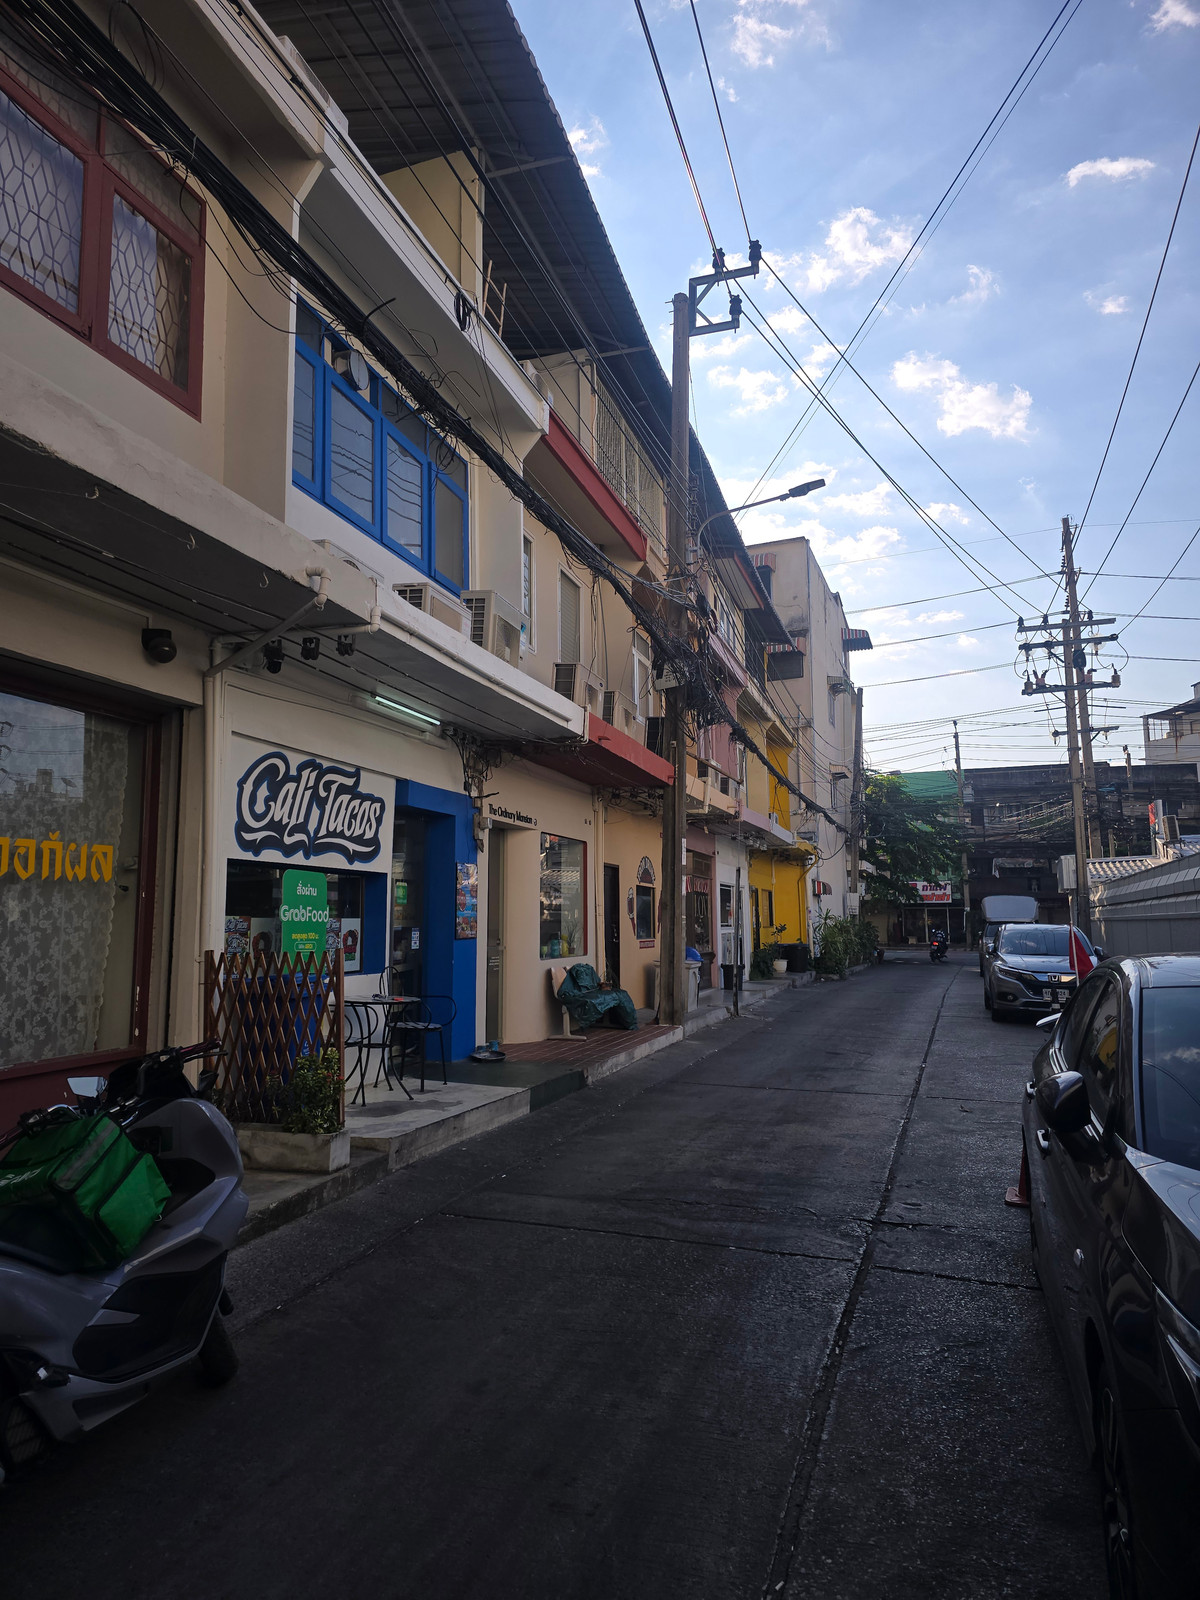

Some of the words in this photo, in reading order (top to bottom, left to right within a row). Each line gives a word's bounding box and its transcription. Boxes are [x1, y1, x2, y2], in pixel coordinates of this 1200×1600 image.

[240, 757, 319, 844] Cali
[318, 774, 383, 842] Tacos
[488, 803, 498, 816] The
[497, 806, 516, 823] Ordinary
[516, 811, 533, 825] Mansion
[296, 880, 318, 896] สั่งผ่าน
[280, 904, 330, 923] GrabFood
